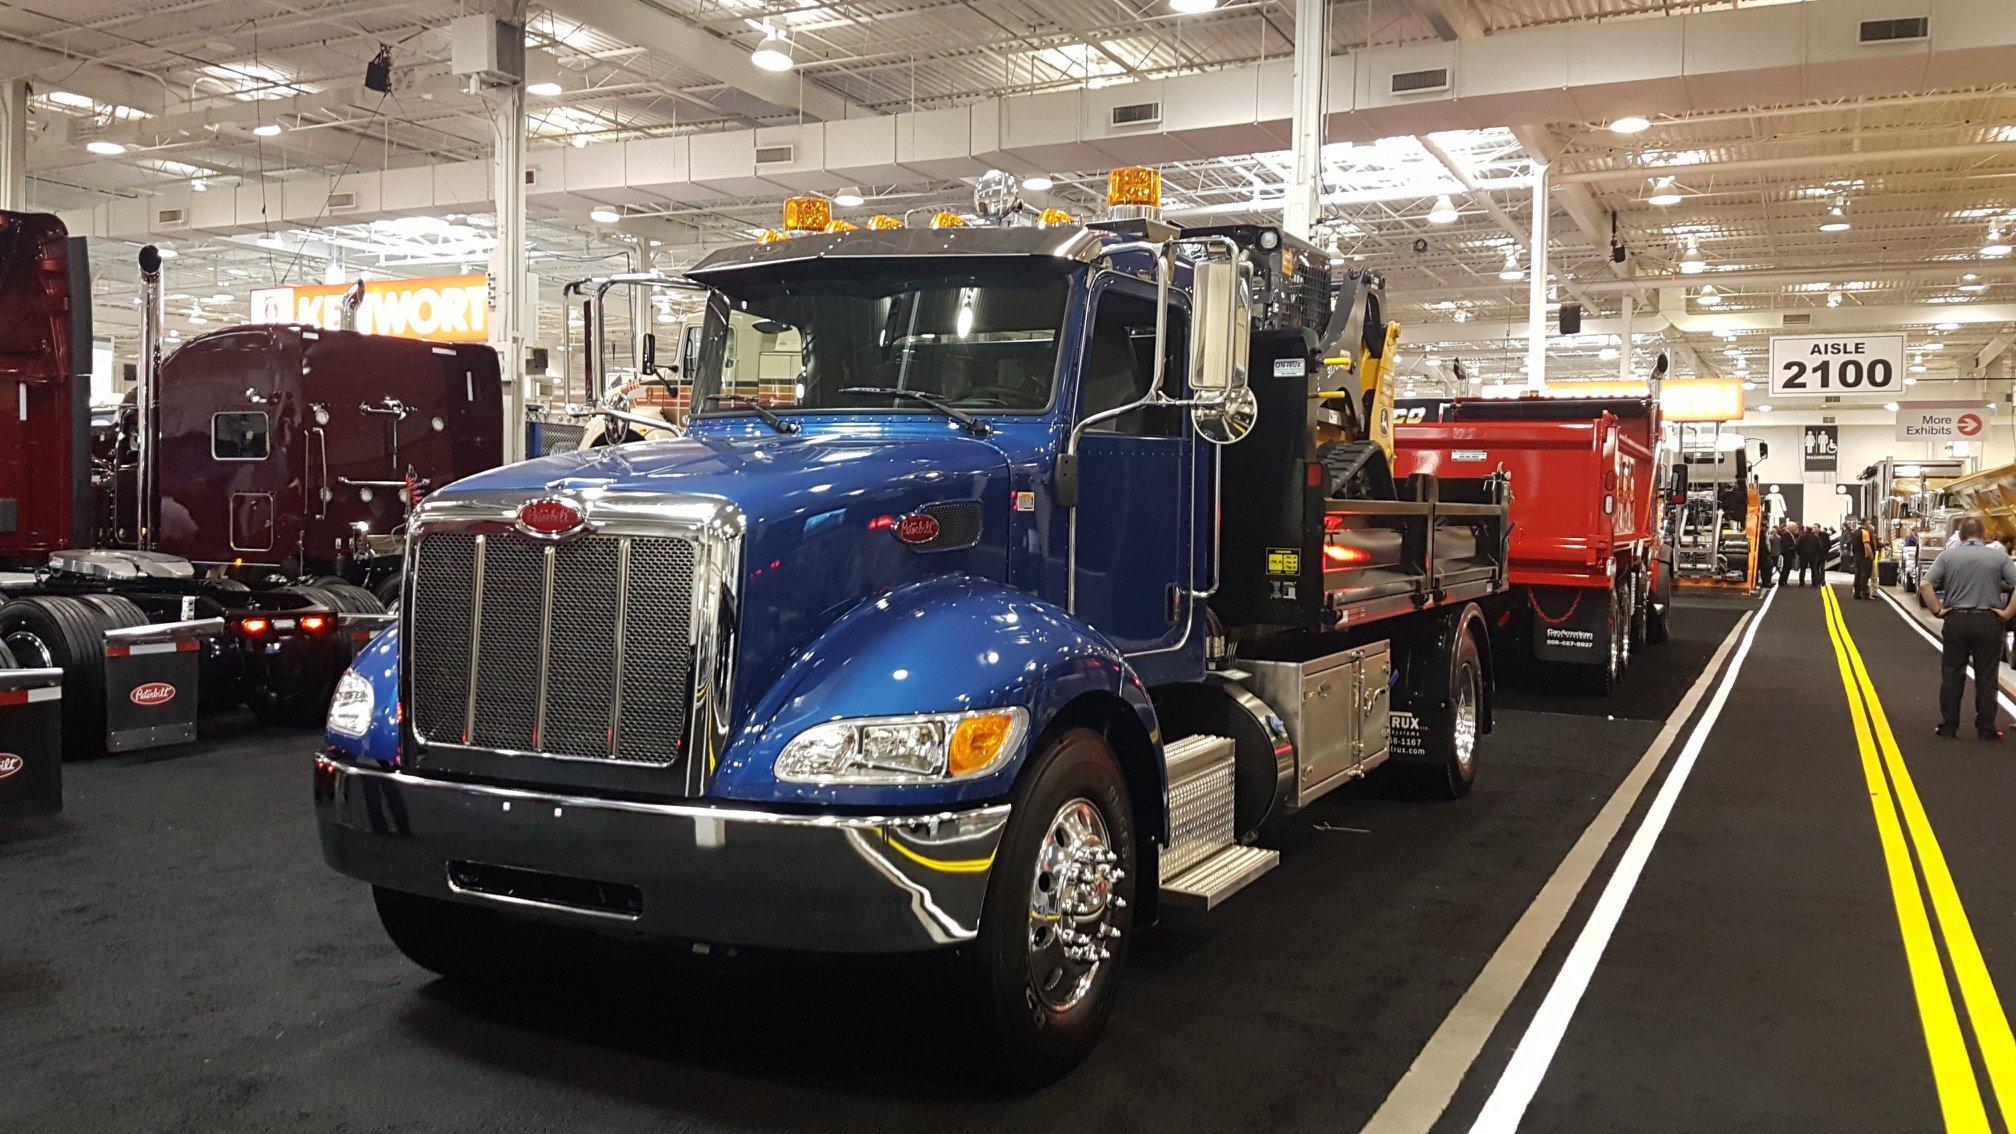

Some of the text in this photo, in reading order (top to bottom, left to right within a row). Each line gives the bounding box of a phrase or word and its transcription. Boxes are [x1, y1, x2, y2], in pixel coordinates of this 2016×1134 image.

[1810, 342, 1866, 355] AISLE
[1782, 358, 1893, 389] 2100
[1922, 415, 1952, 425] More
[1906, 425, 1952, 435] Exhibits
[135, 687, 171, 701] Peterbilt
